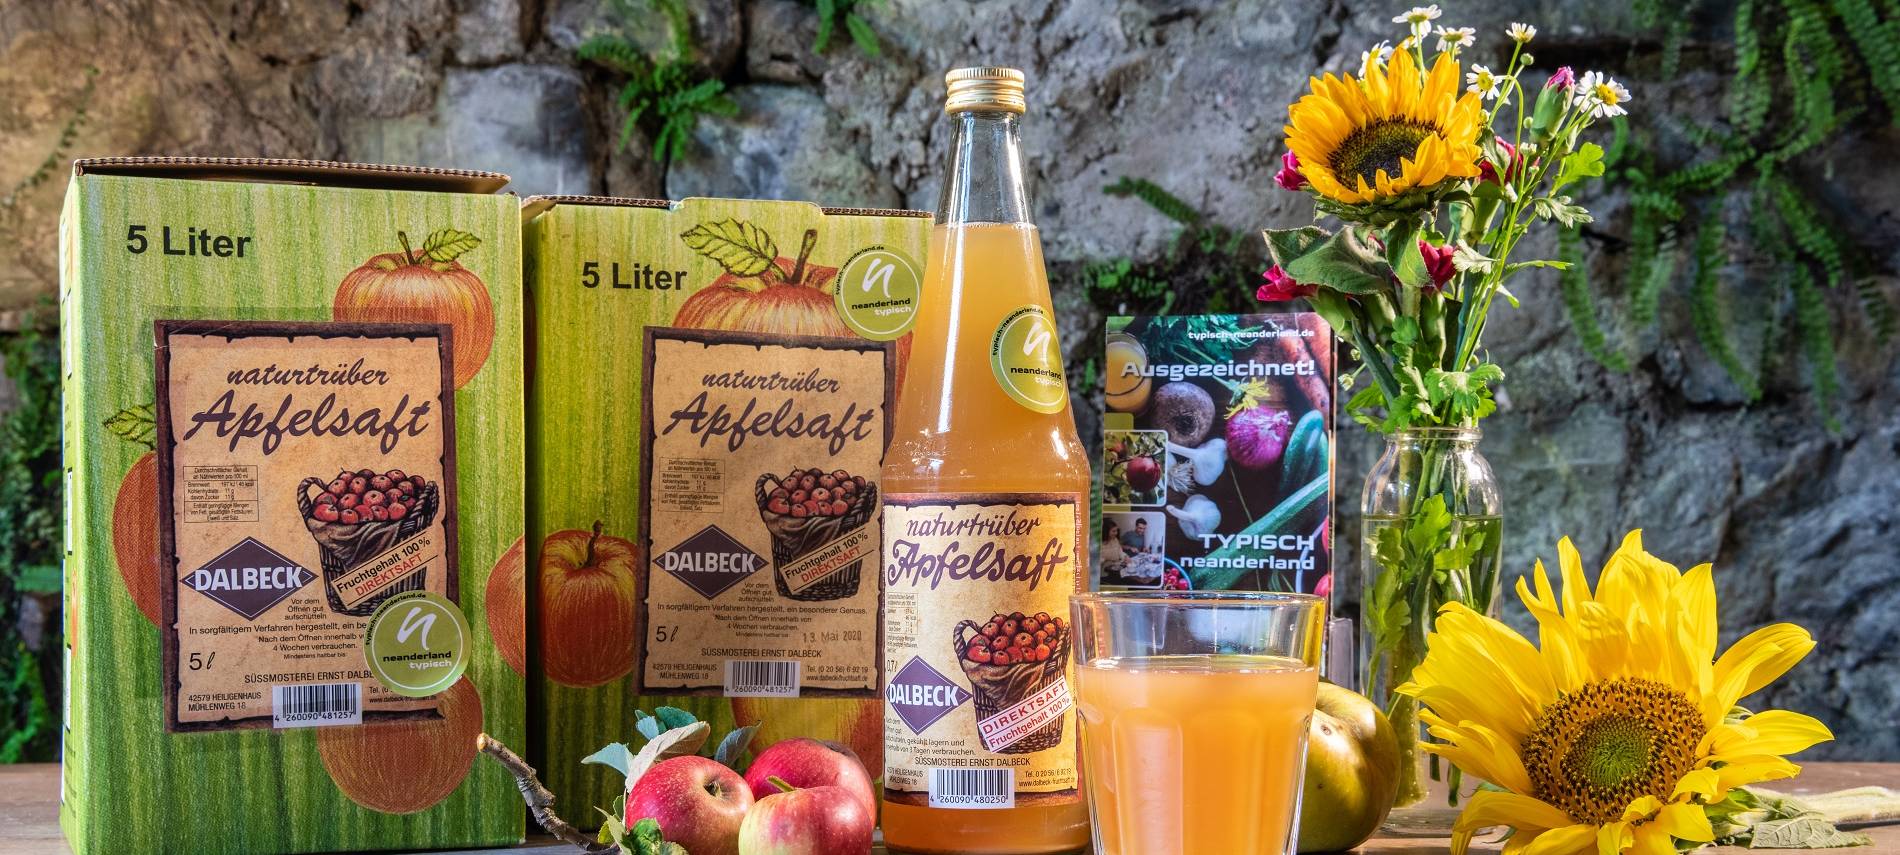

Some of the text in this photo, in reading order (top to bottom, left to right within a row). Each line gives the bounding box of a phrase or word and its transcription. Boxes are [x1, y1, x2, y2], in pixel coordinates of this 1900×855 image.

[127, 225, 251, 257] 5 Liter
[582, 261, 687, 290] 5 Liter
[836, 246, 884, 295] typisch-neanderland.de
[851, 298, 911, 310] neanderland
[874, 306, 911, 316] typisch
[1188, 329, 1315, 342] typisch-neanderland.de
[227, 358, 389, 386] naturtrüber
[1011, 367, 1062, 380] neanderland
[1120, 360, 1316, 382] Ausgezeichnet!
[702, 367, 840, 393] naturtrüber
[183, 389, 431, 455] Apfelsaft
[662, 391, 874, 456] Apfelsaft
[907, 510, 1041, 536] naturtrüber
[1198, 533, 1315, 551] TYPISCH
[664, 552, 756, 573] DALBECK
[785, 546, 842, 579] Fruchtgehalt
[801, 546, 860, 582] DIREKTSAFT
[887, 537, 1068, 591] Apfelsaft
[1180, 555, 1315, 570] neanderland
[195, 567, 302, 590] DALBECK
[336, 552, 402, 594] Fruchtgehalt
[355, 552, 422, 597] DIREKTSAFT
[288, 605, 311, 613] Öffnen
[666, 603, 710, 613] sorgfältigem
[712, 604, 746, 612] Verfahren
[800, 606, 838, 614] besonderer
[840, 607, 867, 615] Genuss.
[365, 592, 427, 645] typisch-neanderland.de
[189, 627, 198, 635] In
[200, 625, 252, 636] sorgfältigem
[254, 624, 294, 633] Verfahren
[296, 622, 340, 632] hergestellt,
[343, 622, 354, 630] ein
[656, 625, 667, 641] 5
[733, 622, 758, 630] Wochen
[259, 635, 278, 643] Nach
[280, 634, 295, 642] dem
[298, 632, 322, 641] Öffnen
[324, 632, 356, 640] innerhalb
[821, 631, 839, 641] Mai
[280, 643, 309, 652] Wochen
[311, 642, 358, 651] verbrauchen.
[701, 647, 822, 658] SÜSSMOSTEREI ERNST DALBECK
[189, 652, 203, 671] 5
[383, 651, 452, 662] neanderland
[408, 660, 452, 670] typisch
[244, 672, 315, 684] SÜSSMOSTEREI
[317, 671, 345, 681] ERNST
[660, 672, 699, 680] MÜHLENWEG
[734, 685, 762, 693] 260090
[889, 684, 958, 707] DALBECK
[188, 692, 262, 702] 42579 HEILIGENHAUS
[188, 702, 235, 712] MÜHLENWEG
[983, 681, 1066, 734] DIREKTSAFT
[286, 712, 319, 722] 260090
[322, 711, 353, 720] 481257
[989, 711, 1049, 747] Fruchtgehalt
[929, 739, 949, 747] lagern
[951, 739, 964, 747] und
[913, 747, 930, 756] Tagen
[932, 748, 976, 756] verbrauchen.
[915, 756, 1031, 767] SÜSSMOSTEREI ERNST DALBECK
[941, 795, 970, 803] 260090
[974, 795, 1006, 803] 480250
